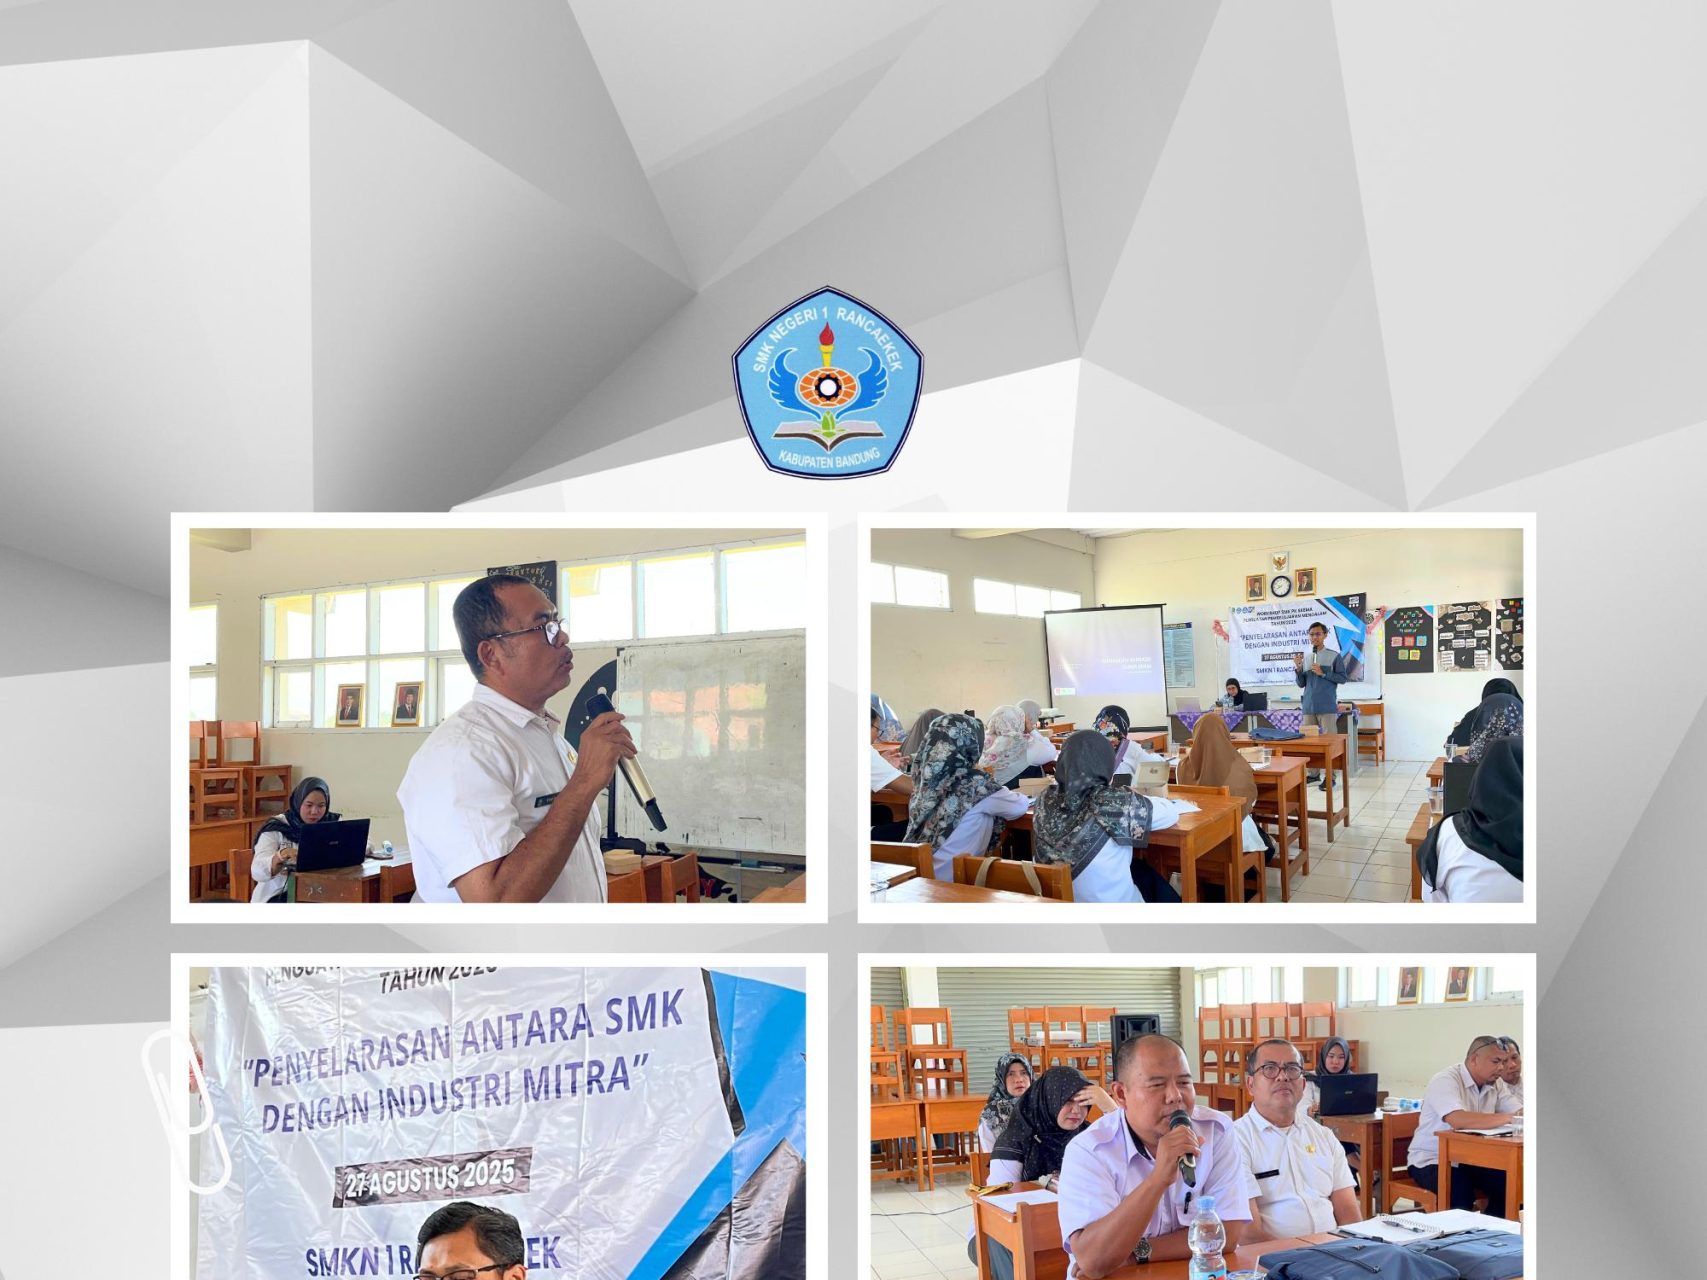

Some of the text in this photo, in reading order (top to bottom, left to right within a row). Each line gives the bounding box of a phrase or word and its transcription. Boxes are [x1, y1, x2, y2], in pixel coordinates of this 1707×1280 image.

[1244, 641, 1270, 649] DENGAN
[1271, 639, 1300, 648] INDUSTRI
[380, 967, 444, 994] TAHUN
[460, 1002, 594, 1056] ANTARA
[605, 988, 684, 1035] SMK
[262, 1091, 369, 1133] DENGAN
[379, 1070, 511, 1121] INDUSTRI
[346, 1158, 515, 1198] 27 AGUSTUS 2025
[306, 1244, 379, 1277] SMKN
[386, 1244, 395, 1275] 1
